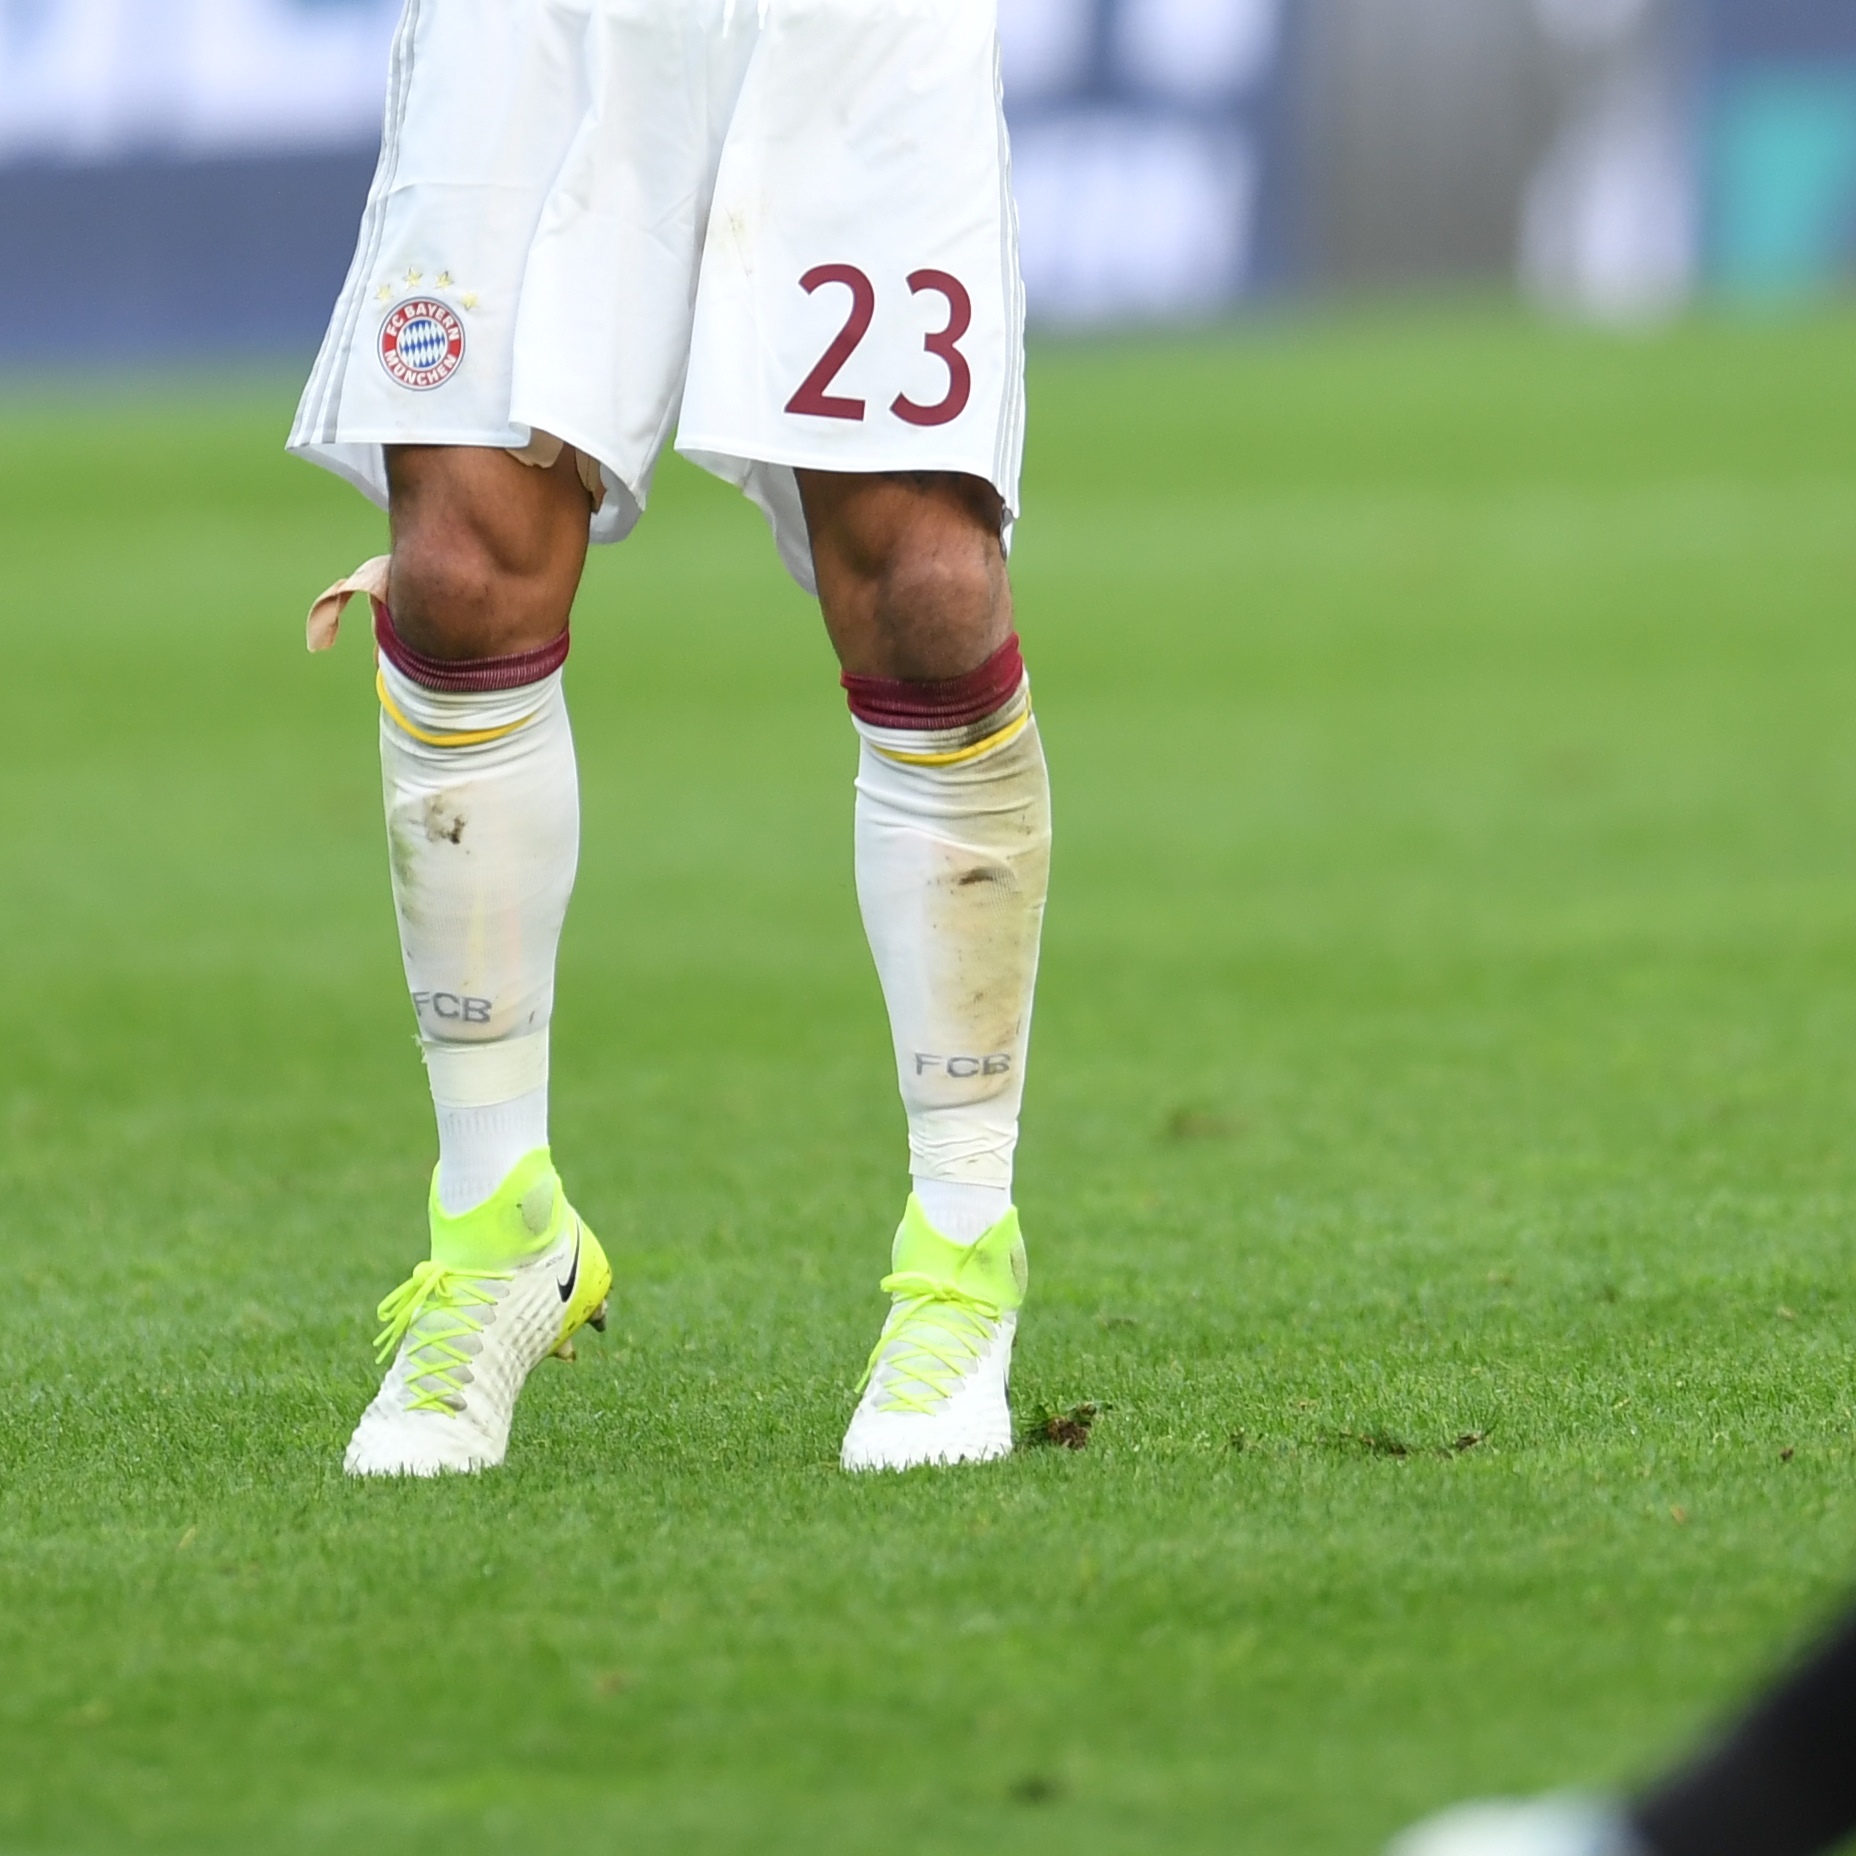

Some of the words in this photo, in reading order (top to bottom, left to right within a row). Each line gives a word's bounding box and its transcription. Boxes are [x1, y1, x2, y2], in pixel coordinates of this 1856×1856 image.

[386, 314, 404, 337] FC
[404, 302, 460, 341] BAYERN
[783, 262, 973, 428] 23
[411, 991, 492, 1023] FCB
[914, 1052, 1011, 1079] FCB
